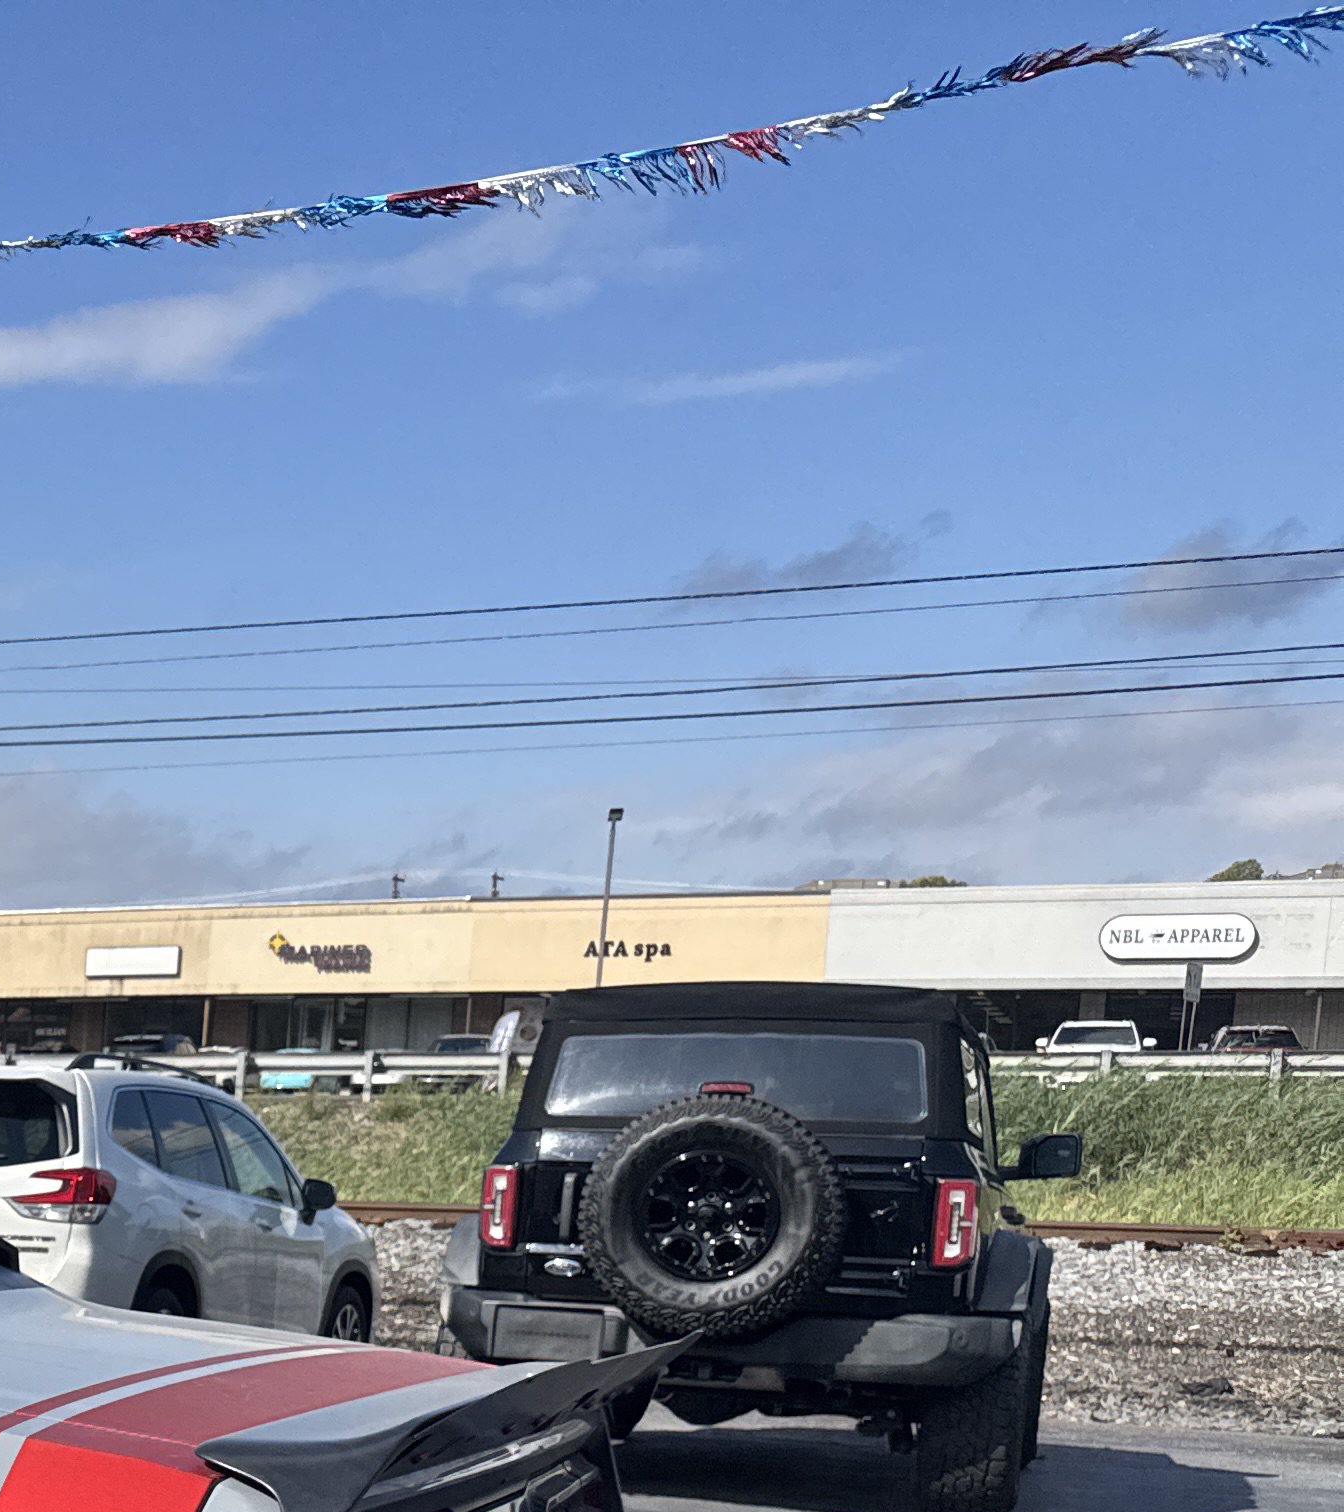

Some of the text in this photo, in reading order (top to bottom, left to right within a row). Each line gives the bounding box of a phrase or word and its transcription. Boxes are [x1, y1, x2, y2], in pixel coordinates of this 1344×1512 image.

[1108, 927, 1245, 945] NBL APPAREL
[633, 943, 672, 963] spa
[635, 1258, 785, 1303] GOODYEAR
